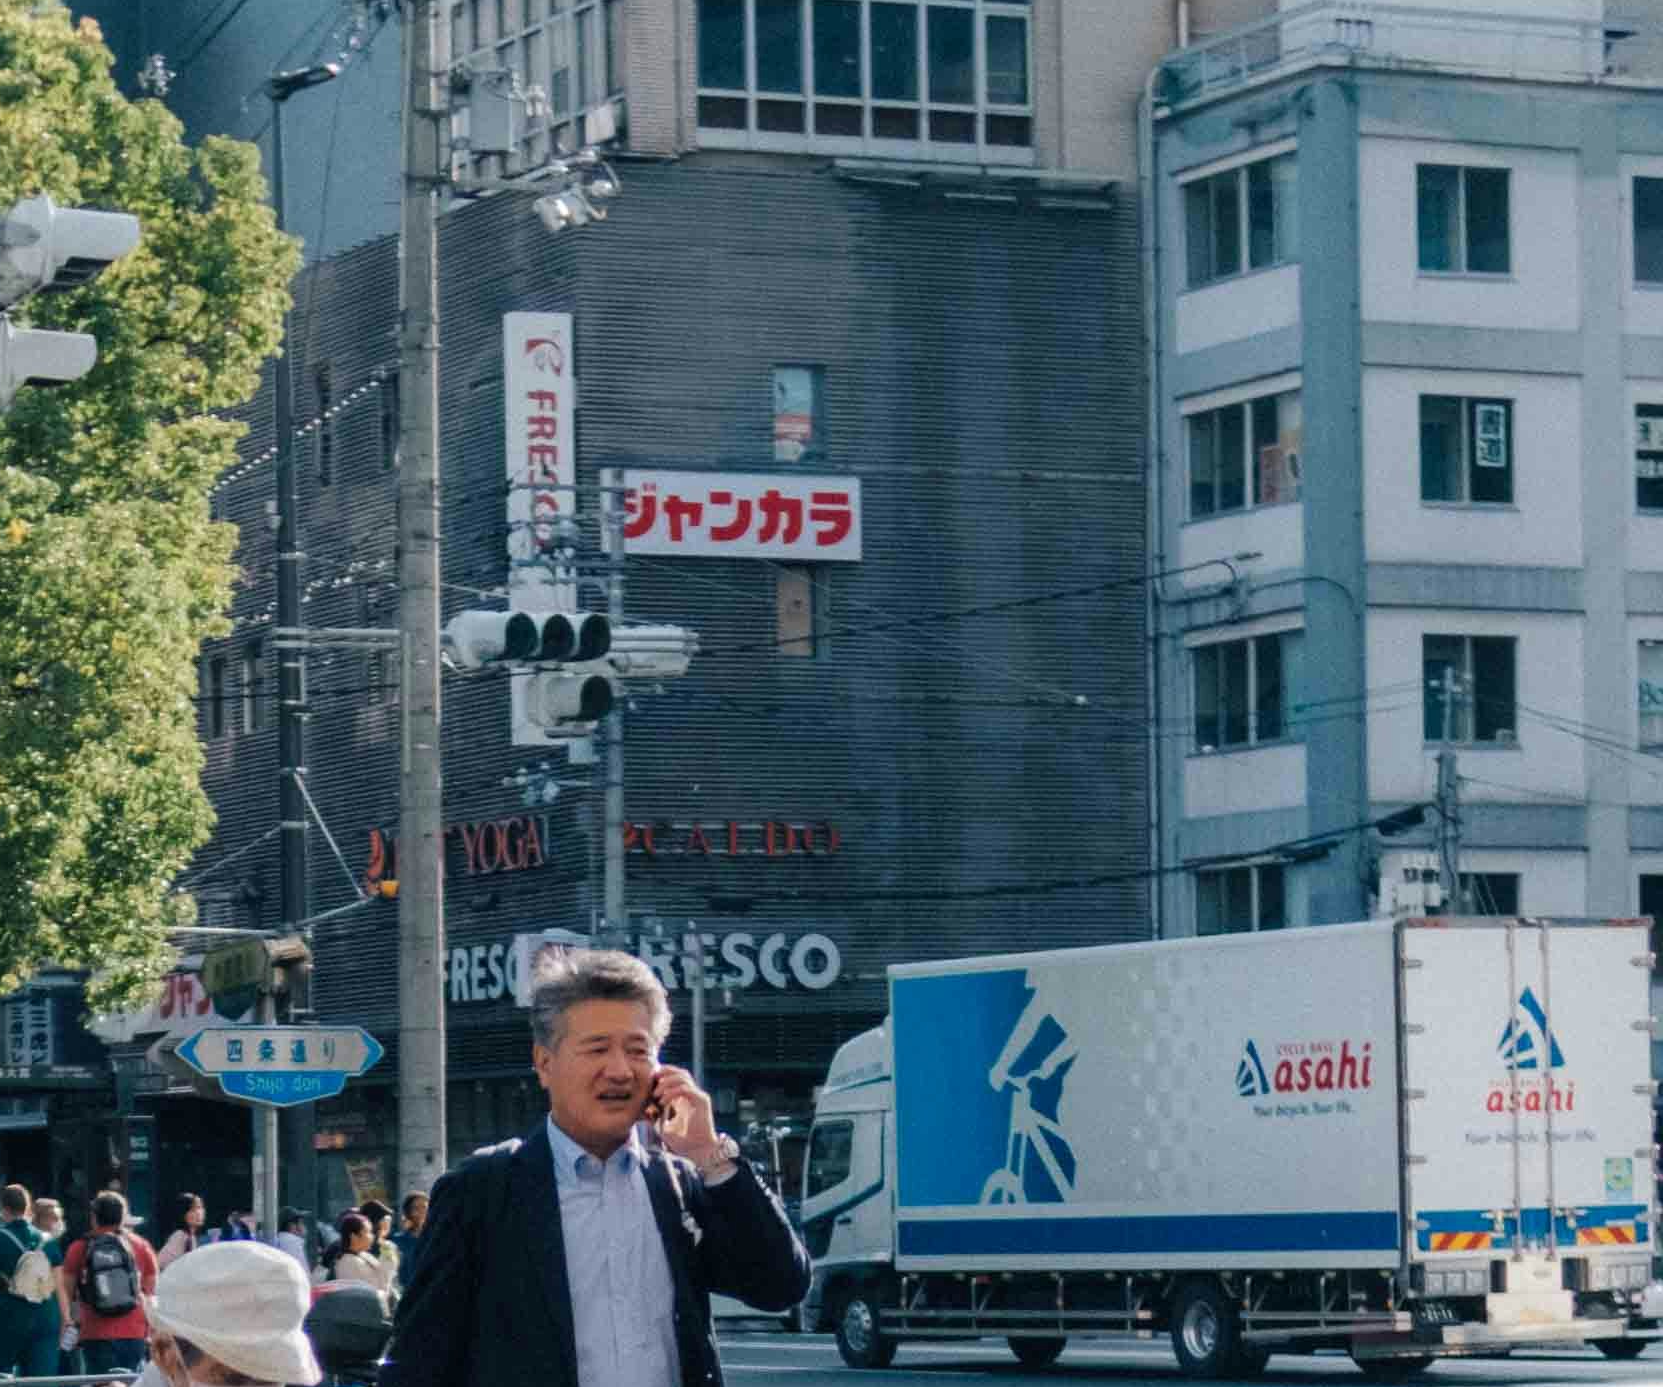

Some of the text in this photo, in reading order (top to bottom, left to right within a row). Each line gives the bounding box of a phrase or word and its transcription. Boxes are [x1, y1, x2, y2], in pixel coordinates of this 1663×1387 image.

[624, 482, 852, 547] ジャンカラ
[462, 816, 546, 876] YOGA
[638, 933, 841, 990] RESCO
[227, 1038, 336, 1063] 四条通り
[1274, 1039, 1372, 1093] asahi
[1486, 1077, 1575, 1112] asahi
